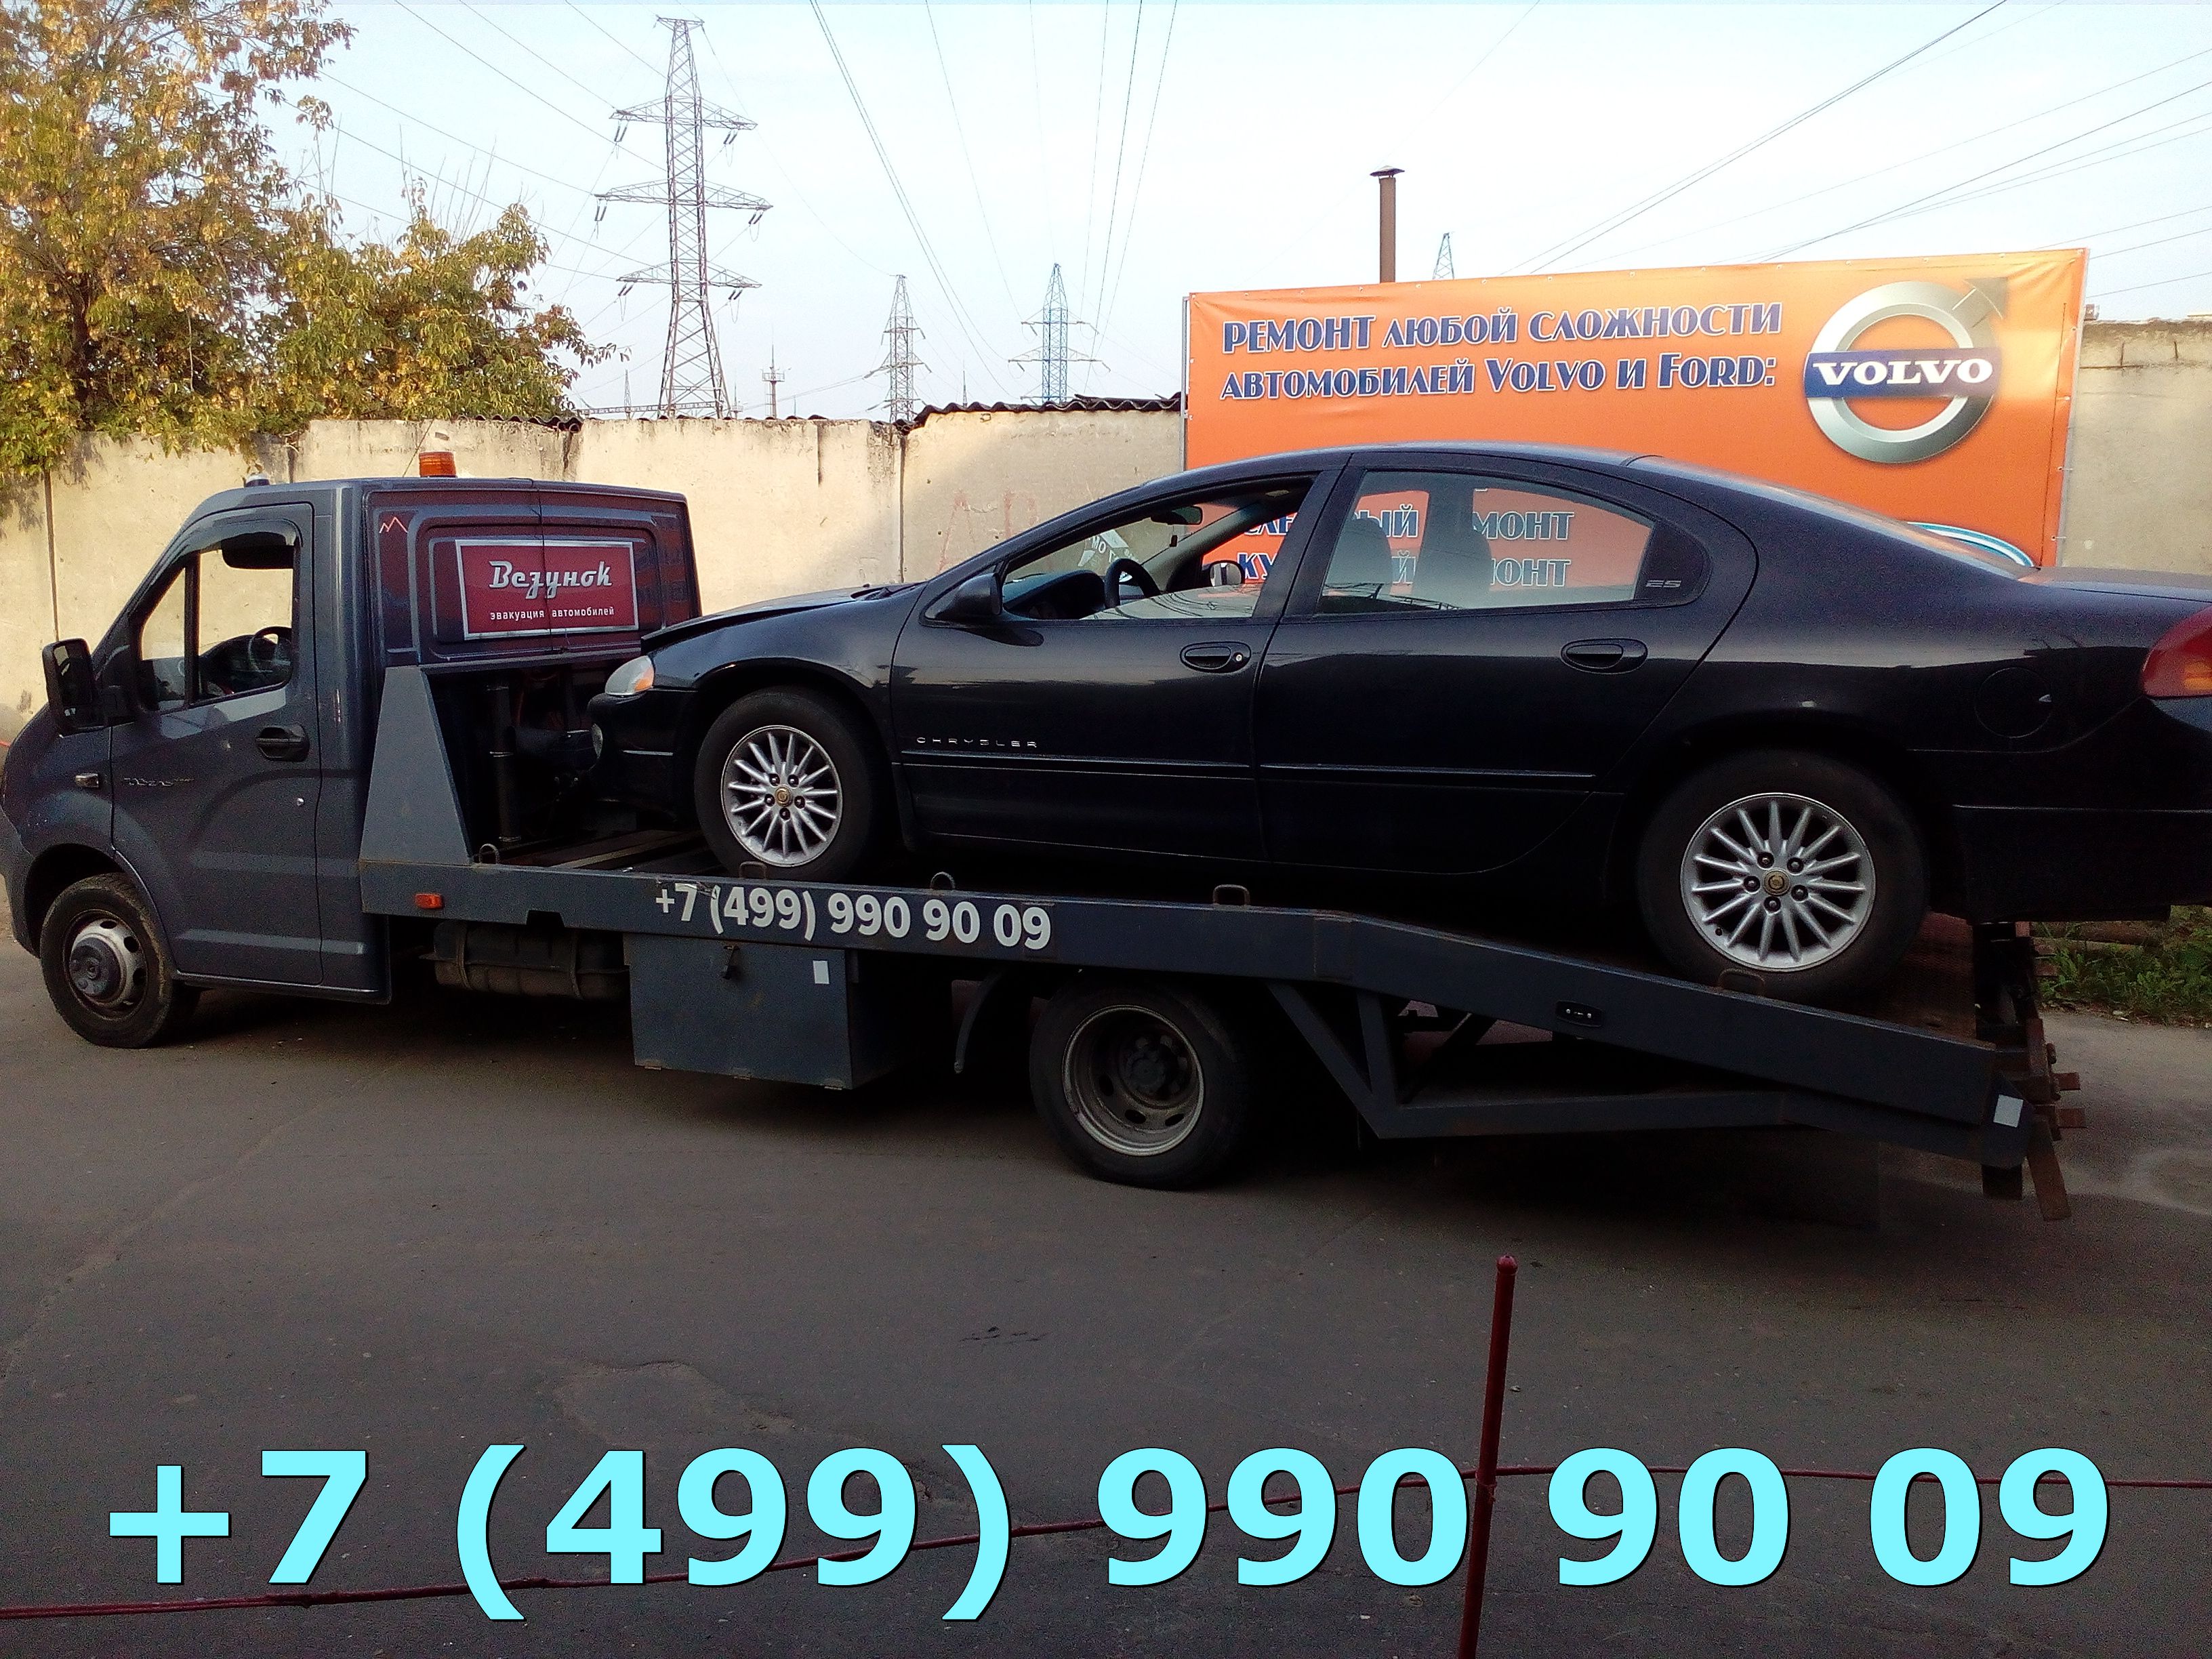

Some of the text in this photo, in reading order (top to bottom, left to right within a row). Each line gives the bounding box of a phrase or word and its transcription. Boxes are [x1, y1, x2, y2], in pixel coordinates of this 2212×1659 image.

[1223, 302, 1782, 354] РЕМОНТ ЛЮБОЙ СЛОЖНОСТИ
[1220, 358, 1475, 400] АВТОМОБИЛЕЙ
[1813, 358, 1993, 386] VOLVO
[1473, 511, 1575, 540] МОНТ
[489, 560, 613, 600] Везунок
[1645, 579, 1682, 588] ES
[490, 607, 615, 621] эвакуация автомобилей
[916, 736, 1038, 749] CHRYSLER
[655, 882, 1051, 950] +7 (499) 990 90 09
